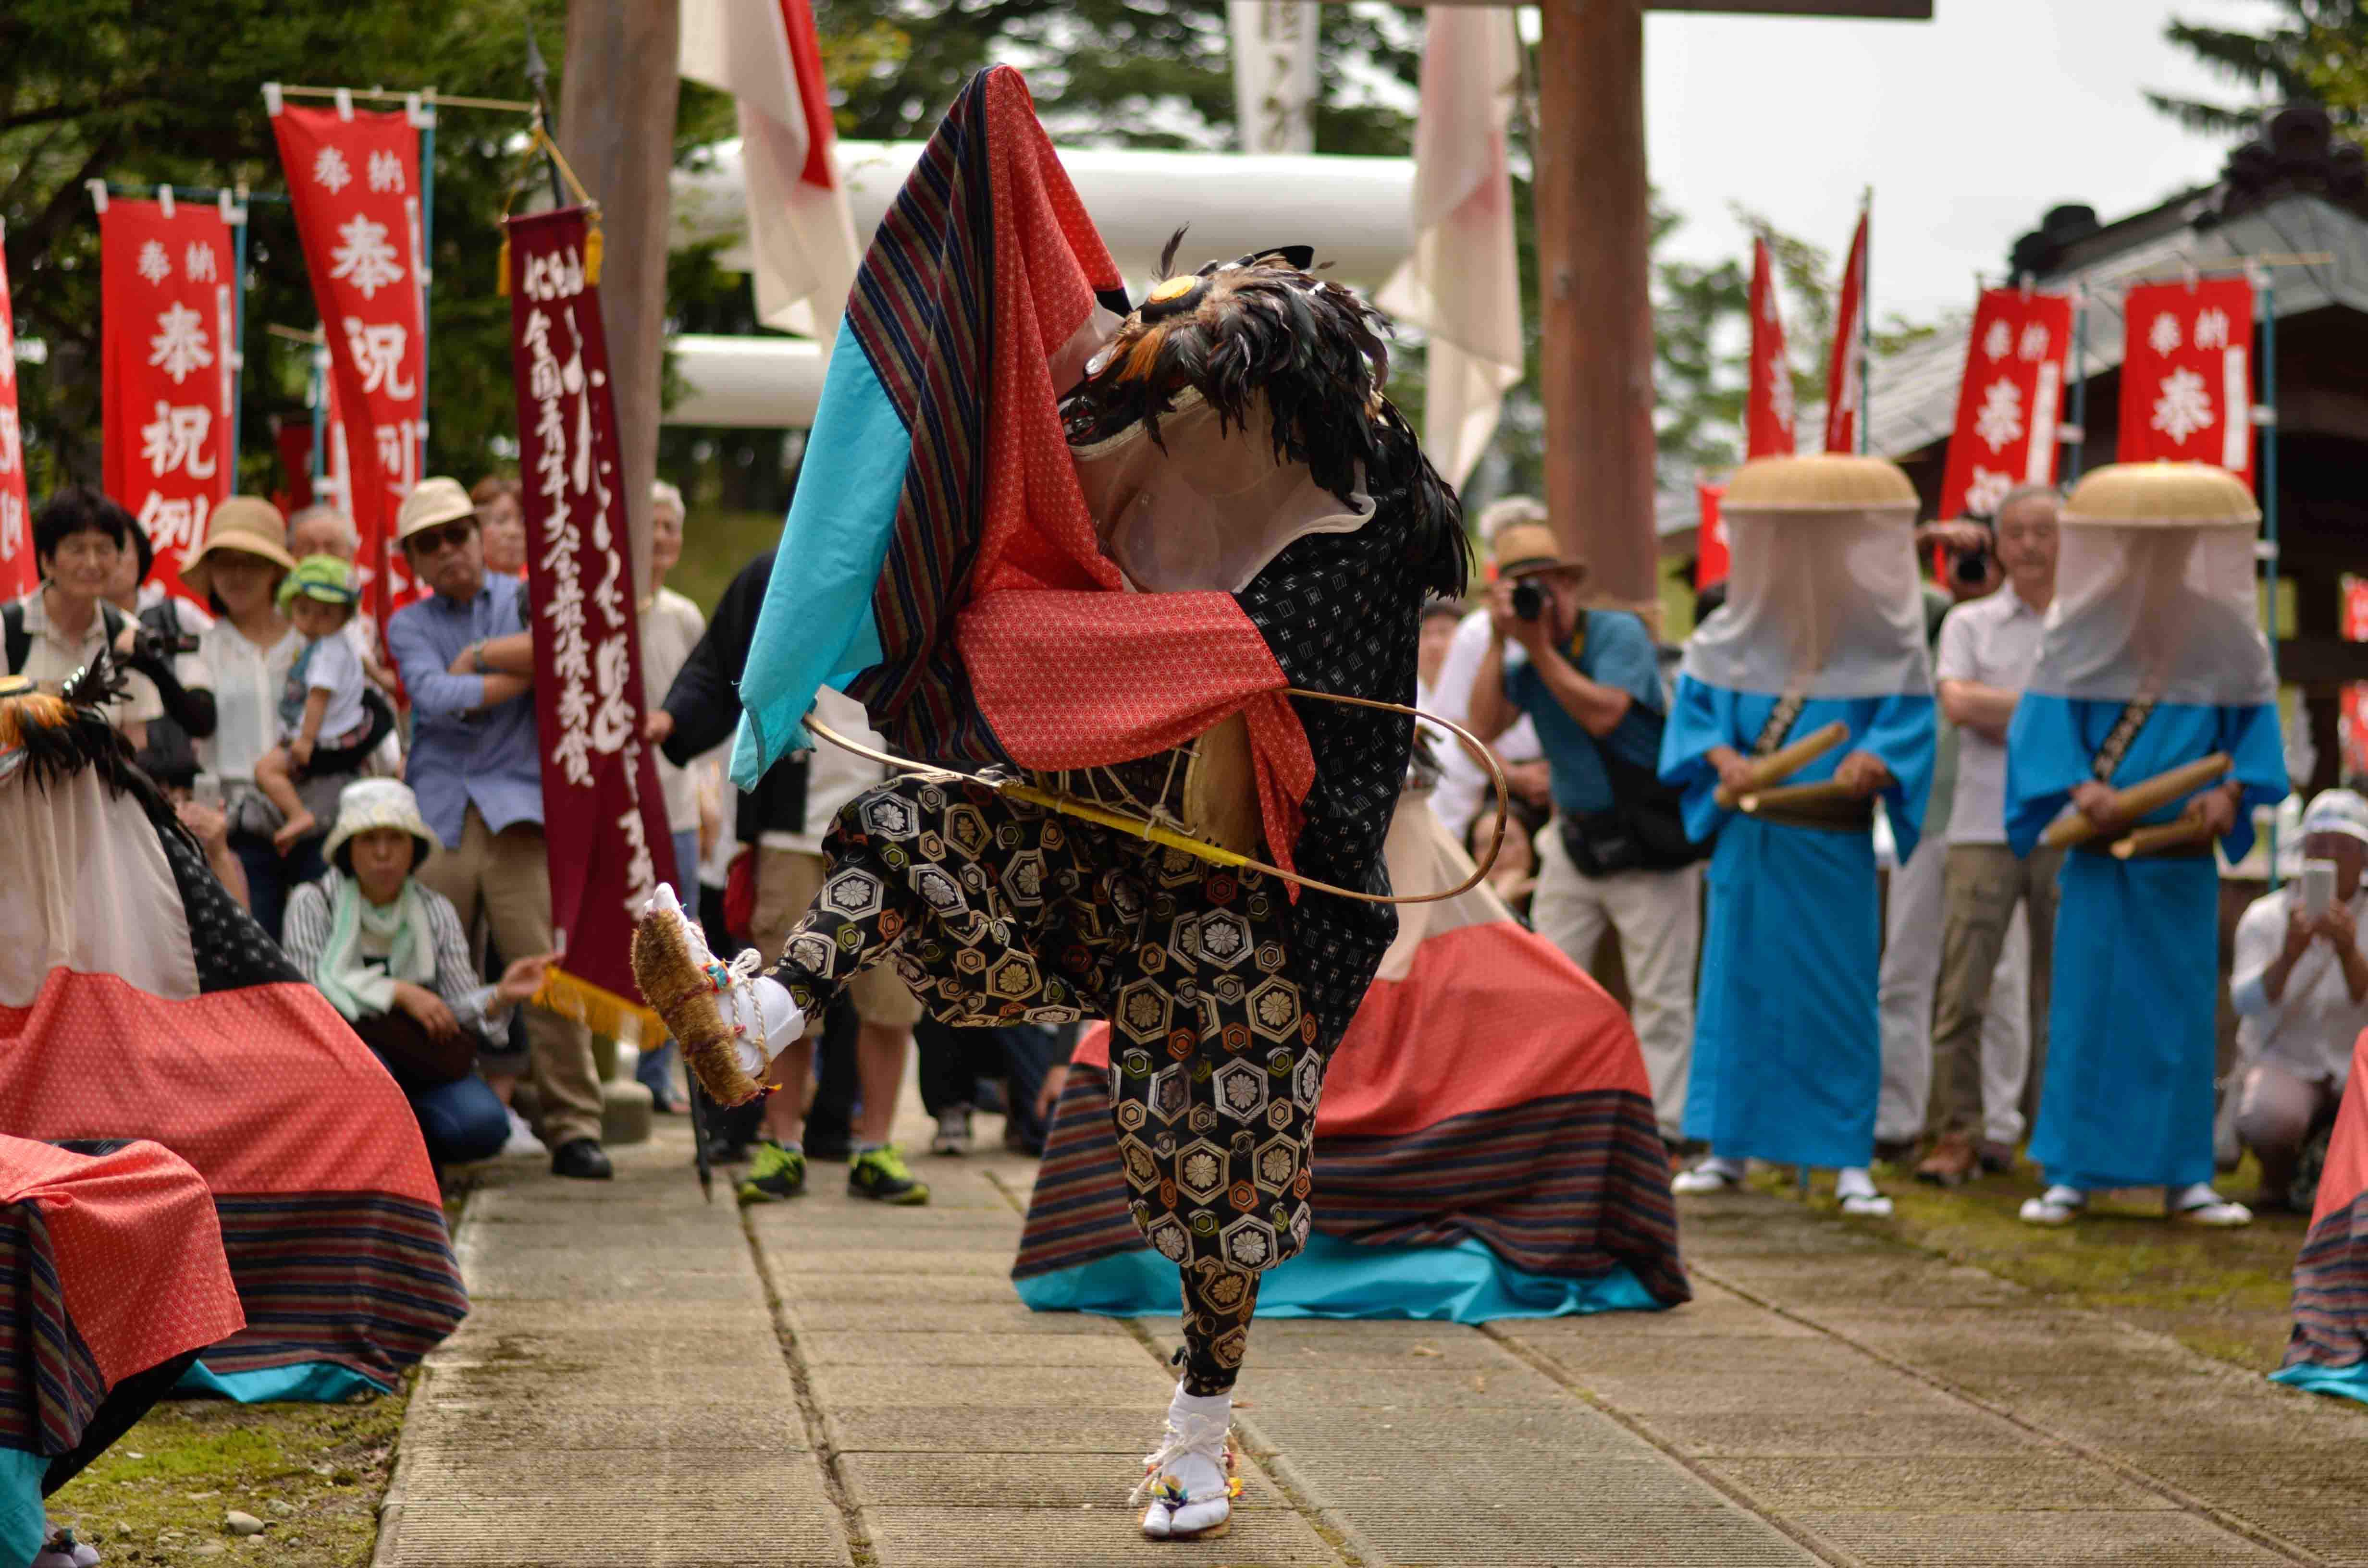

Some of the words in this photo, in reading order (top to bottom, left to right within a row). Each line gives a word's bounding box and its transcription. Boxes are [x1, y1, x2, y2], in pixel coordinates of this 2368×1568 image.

[314, 145, 406, 195] 奉納
[137, 239, 217, 286] 奉納
[137, 300, 216, 601] 奉祝例
